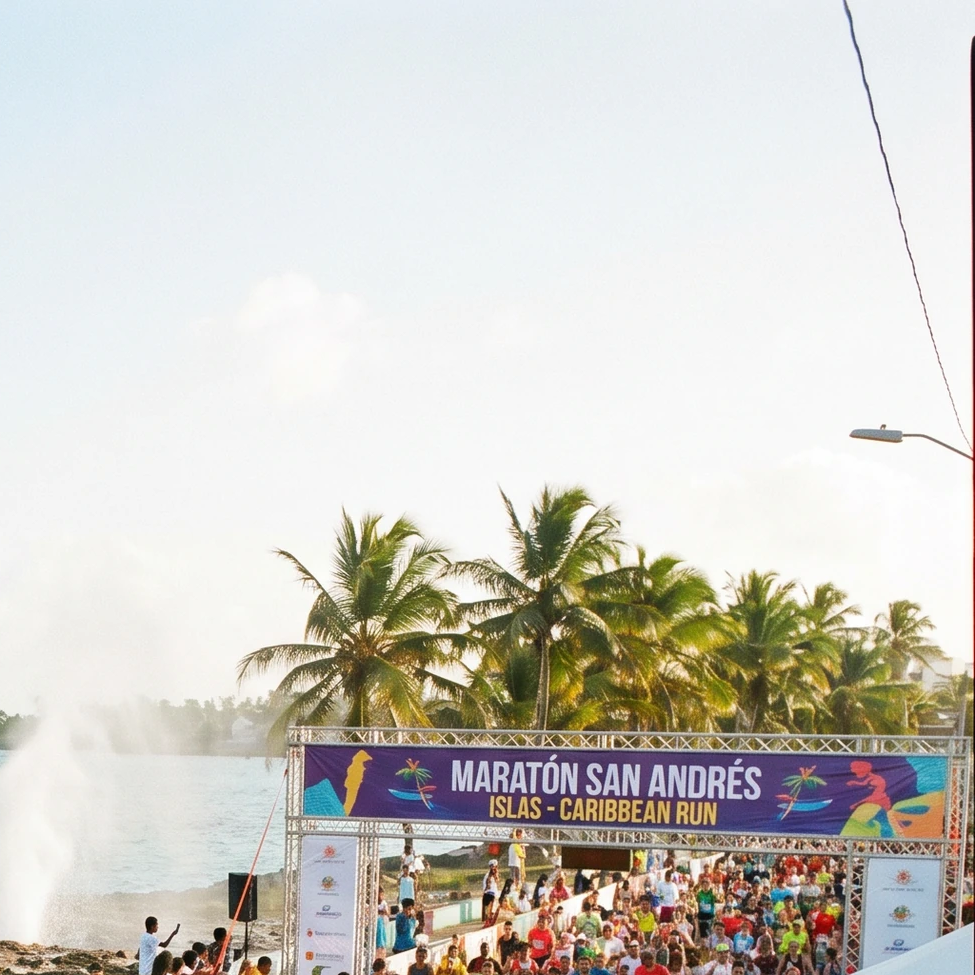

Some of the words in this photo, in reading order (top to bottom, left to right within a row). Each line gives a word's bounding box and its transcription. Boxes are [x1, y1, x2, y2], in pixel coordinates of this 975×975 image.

[451, 754, 578, 796] MARATÓN
[585, 762, 641, 797] SAN
[648, 758, 762, 800] ANDRÉS
[489, 795, 542, 820] ISLAS
[559, 798, 671, 824] CARIBBEAN
[676, 801, 717, 826] RUN
